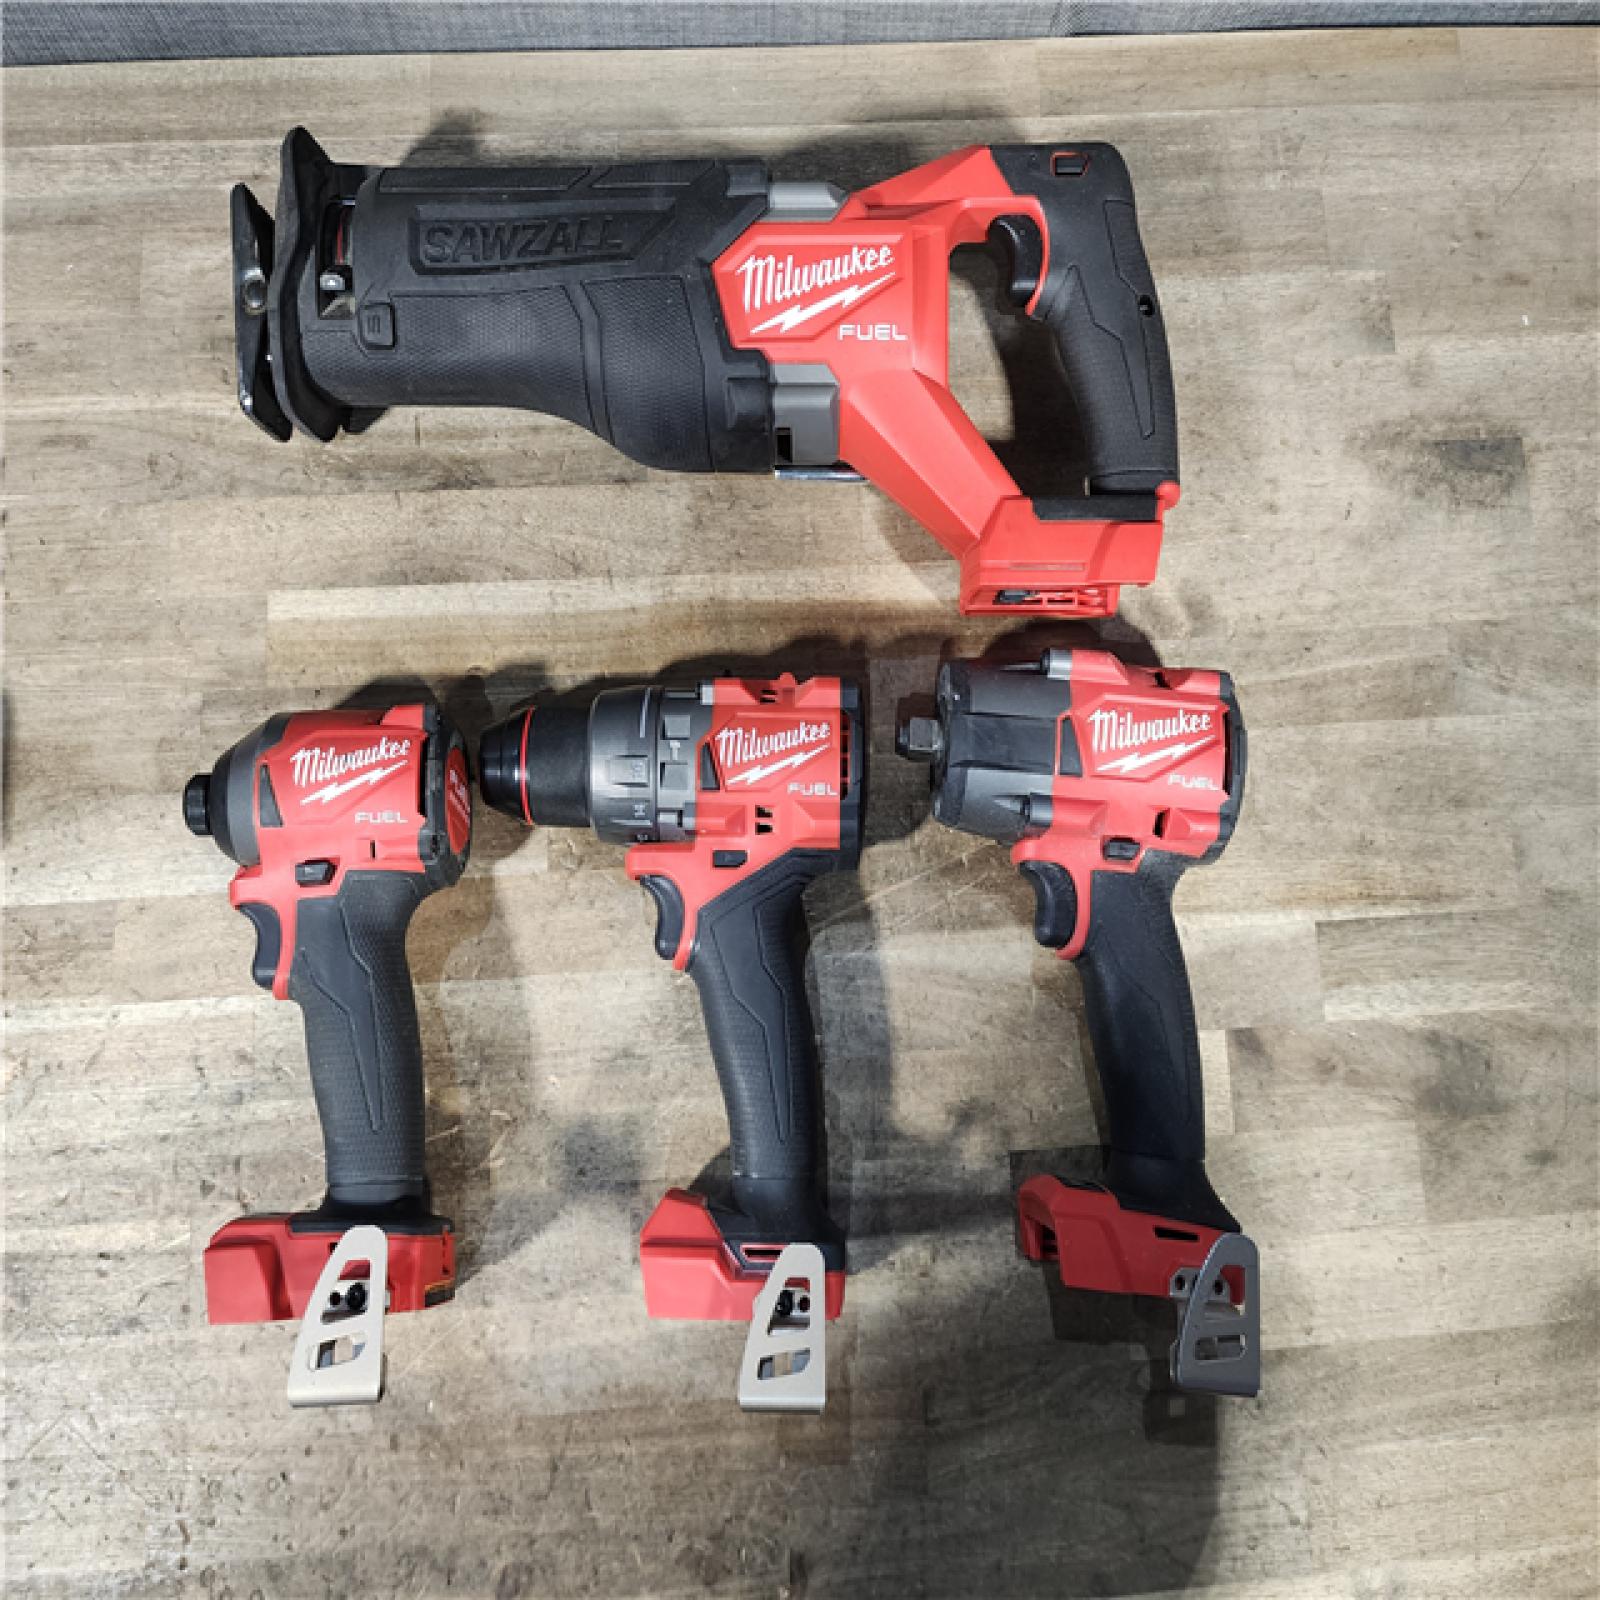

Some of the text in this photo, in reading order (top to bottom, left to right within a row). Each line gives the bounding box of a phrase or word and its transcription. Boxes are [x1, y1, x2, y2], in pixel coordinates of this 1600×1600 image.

[424, 216, 623, 263] SAWZALL
[736, 244, 894, 313] Milwaukee
[838, 323, 907, 341] FUEL
[716, 722, 831, 767] Milwaukee
[1089, 709, 1212, 752] Milwaukee
[290, 736, 411, 787] Milwaukee
[1168, 774, 1219, 791] FUEL
[788, 783, 838, 796] FUEL
[354, 811, 408, 824] FUEL
